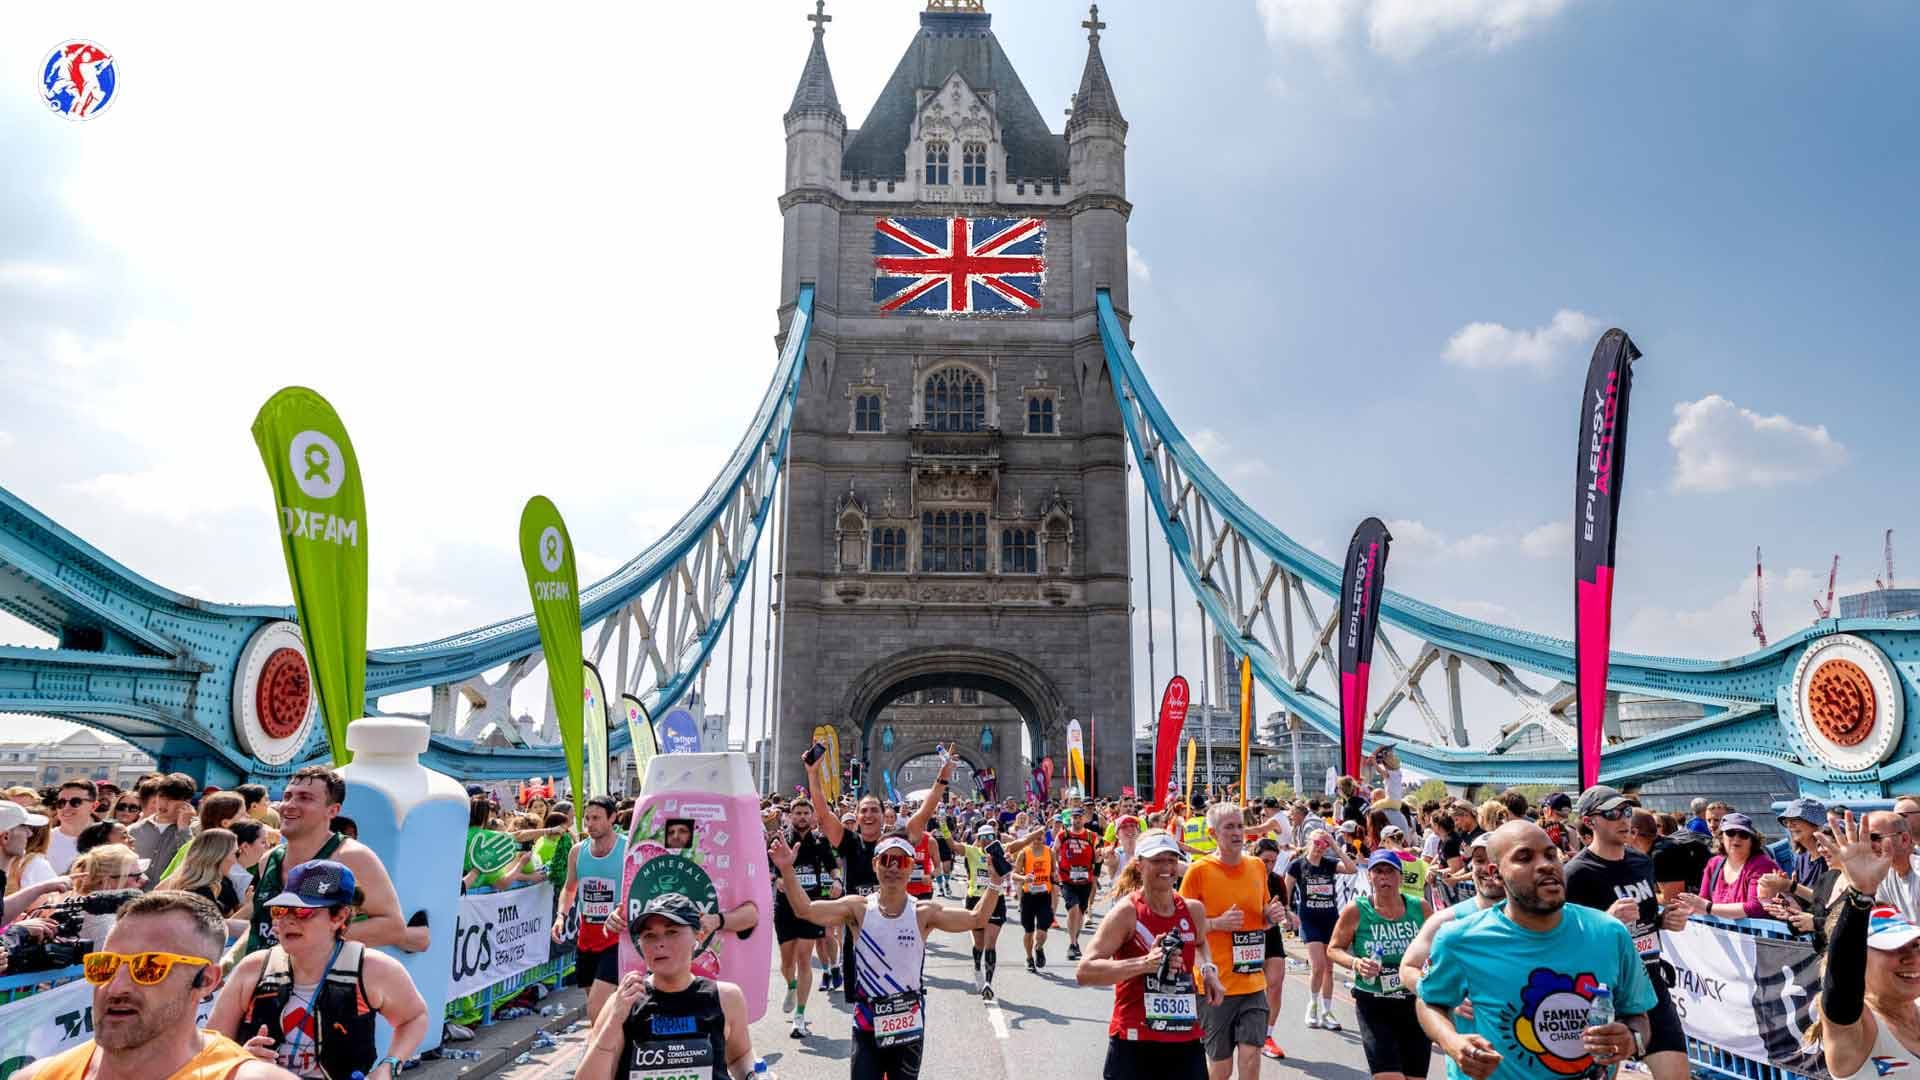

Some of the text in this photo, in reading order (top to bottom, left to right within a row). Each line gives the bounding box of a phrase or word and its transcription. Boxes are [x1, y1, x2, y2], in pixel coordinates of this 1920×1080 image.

[1584, 389, 1605, 542] EPILEPSY
[1348, 553, 1368, 648] EPILEPSY
[643, 859, 701, 881] MINERAL
[498, 904, 519, 924] TATA
[1153, 998, 1190, 1014] 56303
[1543, 1008, 1590, 1020] FAMILY
[882, 1015, 915, 1032] 26282
[1539, 1020, 1587, 1033] HOLIDA
[636, 1047, 665, 1065] tcs
[667, 1049, 708, 1058] CONSULTANCY
[667, 1057, 694, 1065] SERVICES
